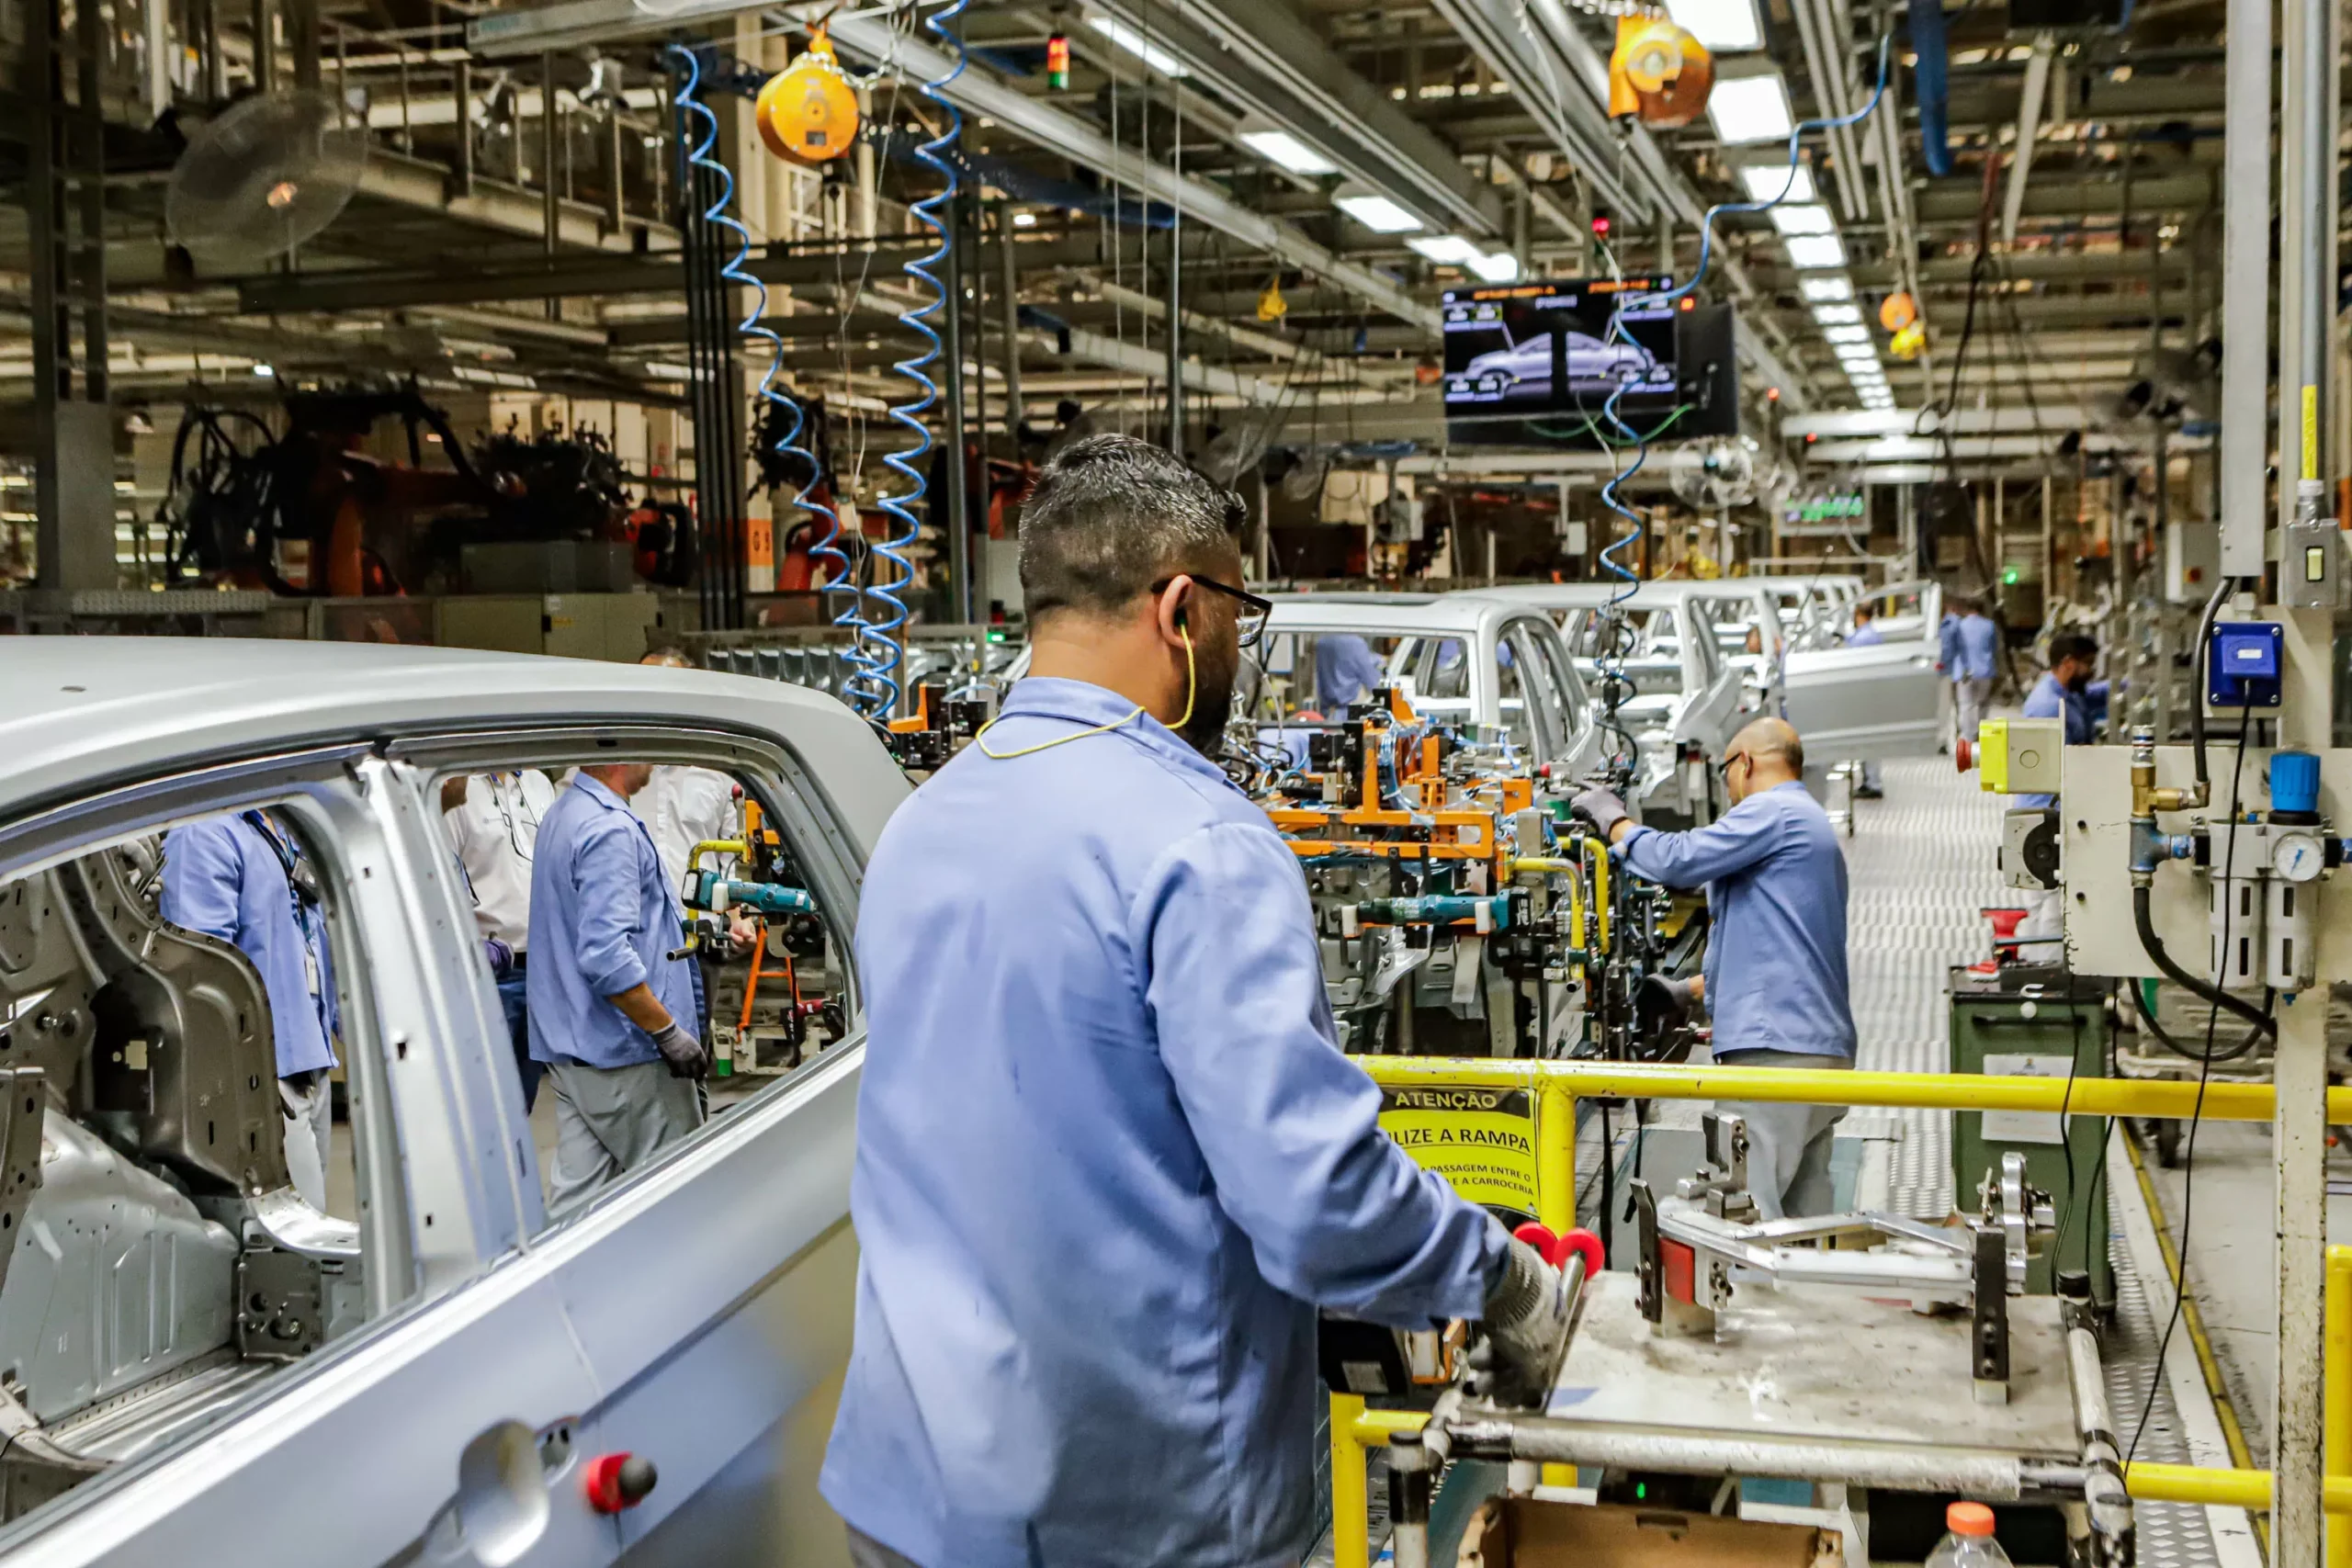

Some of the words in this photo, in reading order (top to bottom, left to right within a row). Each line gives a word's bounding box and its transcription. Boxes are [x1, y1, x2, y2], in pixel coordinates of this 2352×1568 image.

[1396, 1091, 1497, 1111] ATENÇÃO
[1440, 1129, 1453, 1143] A
[1460, 1129, 1531, 1153] RAMPA
[1490, 1166, 1521, 1179] ENTRE
[1523, 1173, 1531, 1182] O
[1462, 1177, 1469, 1185] A
[1472, 1177, 1534, 1197] CARROCERIA
